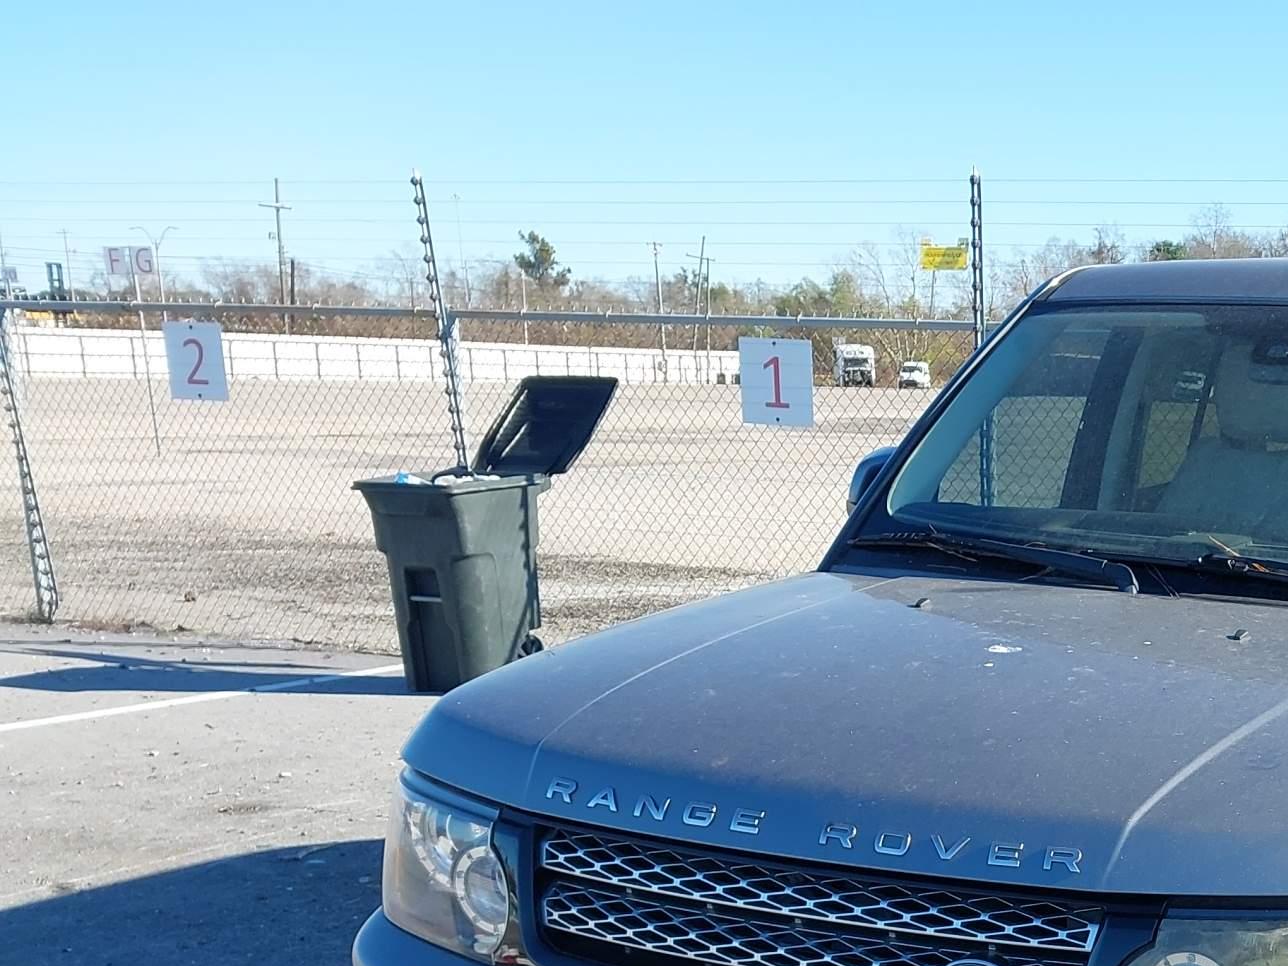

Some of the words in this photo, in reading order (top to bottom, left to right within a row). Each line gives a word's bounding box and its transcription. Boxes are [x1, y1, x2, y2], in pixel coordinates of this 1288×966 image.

[108, 247, 120, 273] F
[135, 247, 152, 273] G
[183, 338, 209, 384] 2
[763, 356, 790, 408] 1
[546, 776, 766, 835] RANGE
[818, 823, 1083, 874] ROVER
